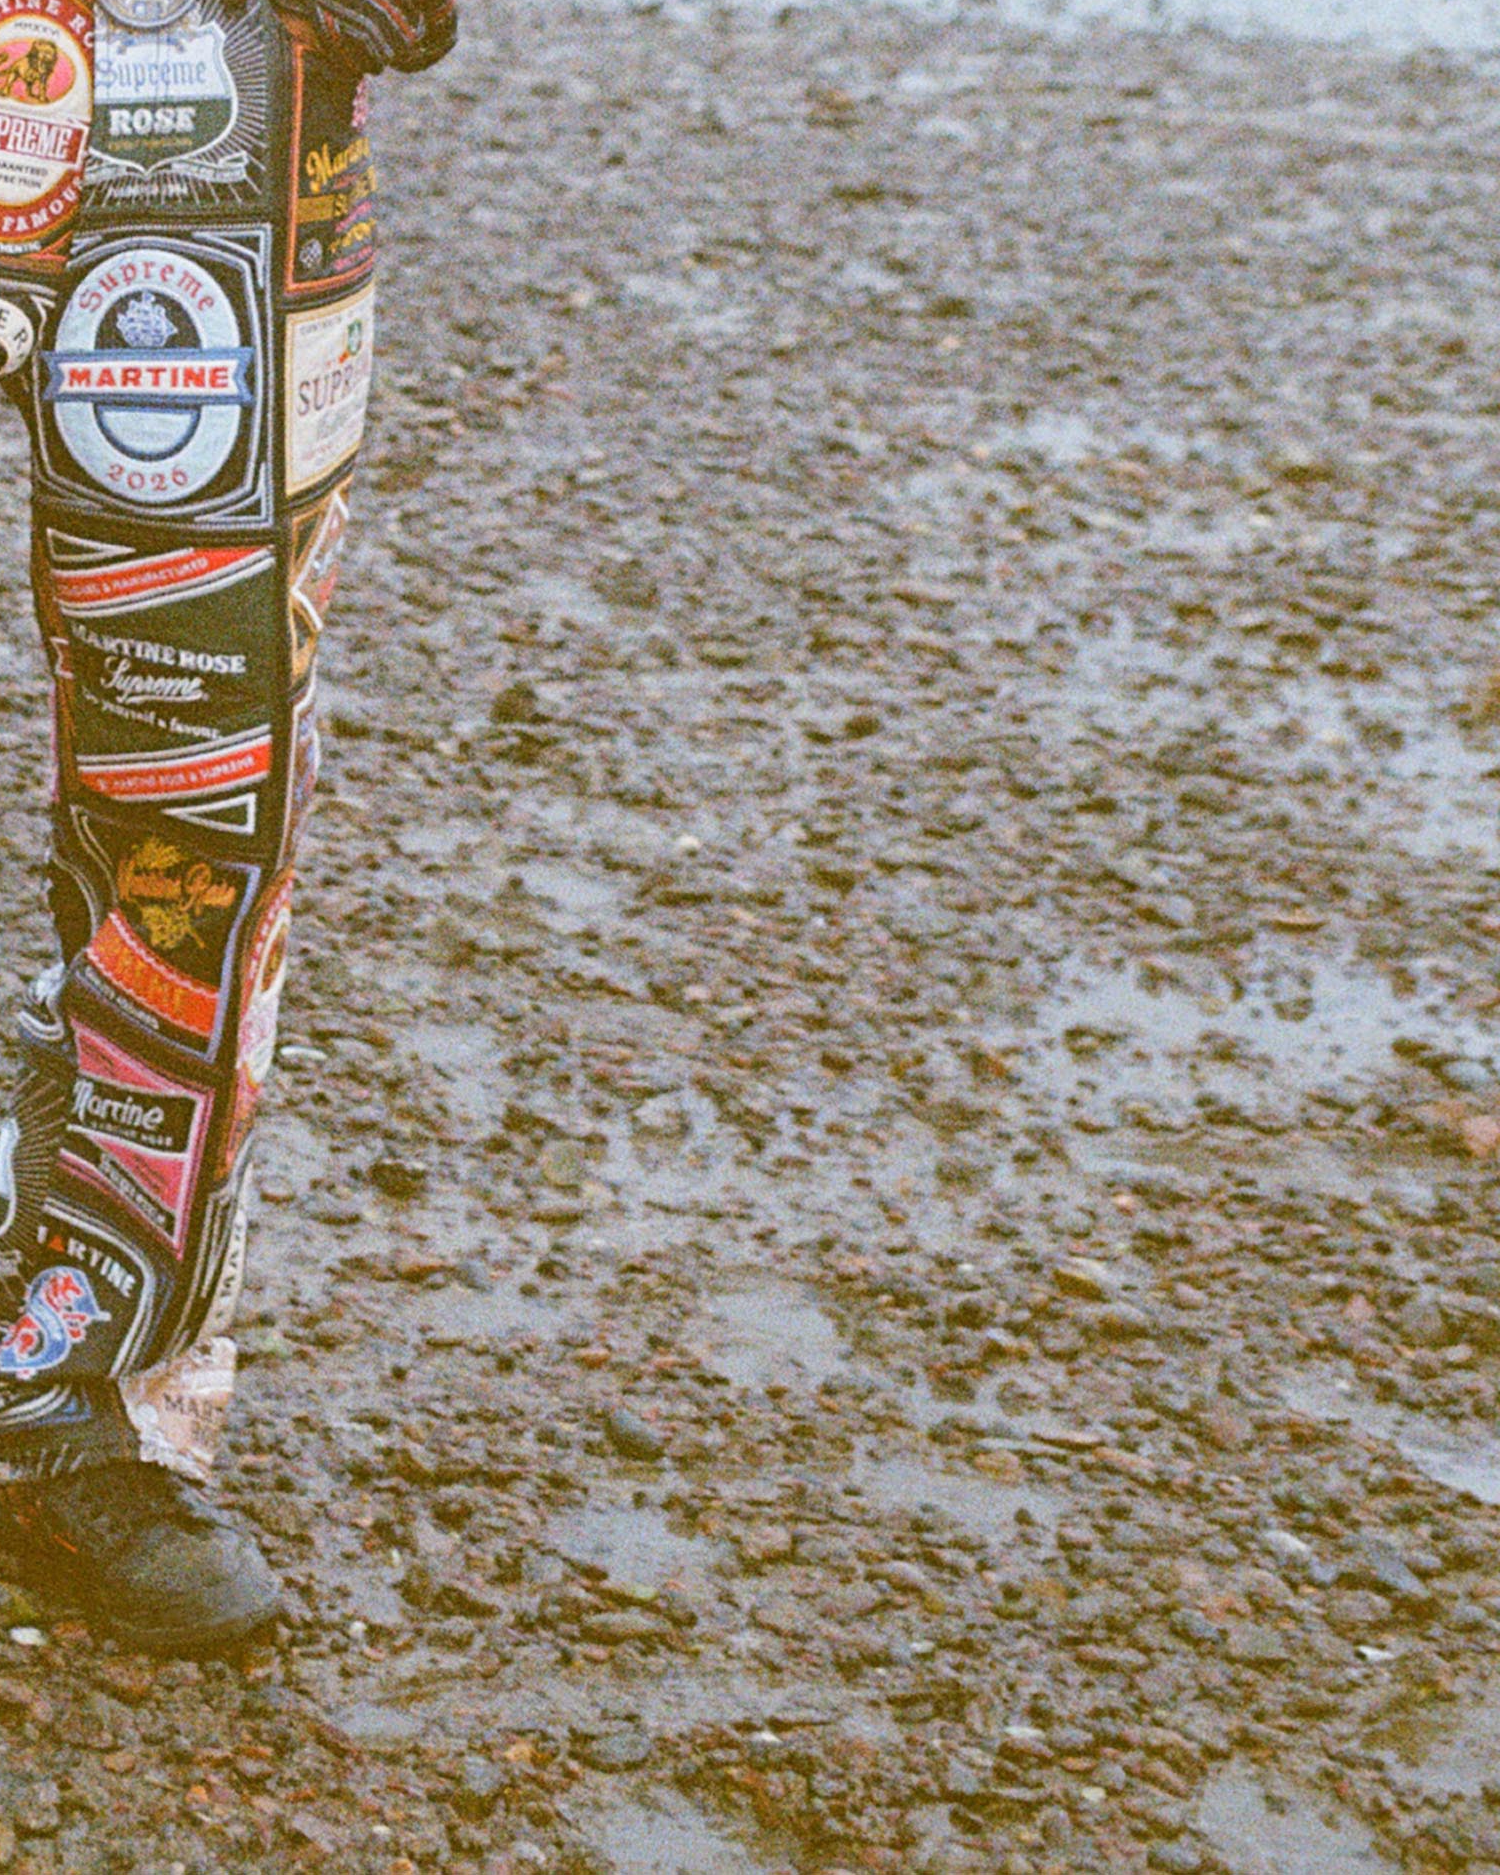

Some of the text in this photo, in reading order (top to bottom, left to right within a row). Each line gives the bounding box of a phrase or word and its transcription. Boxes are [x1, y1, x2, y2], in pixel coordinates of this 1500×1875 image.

[96, 58, 207, 92] Supreme
[109, 107, 197, 136] ROSE
[79, 260, 215, 313] Supreme
[67, 366, 230, 390] MARTINE
[108, 463, 190, 492] 2026
[70, 620, 247, 674] MARTINE ROSE
[71, 1076, 166, 1130] Martine
